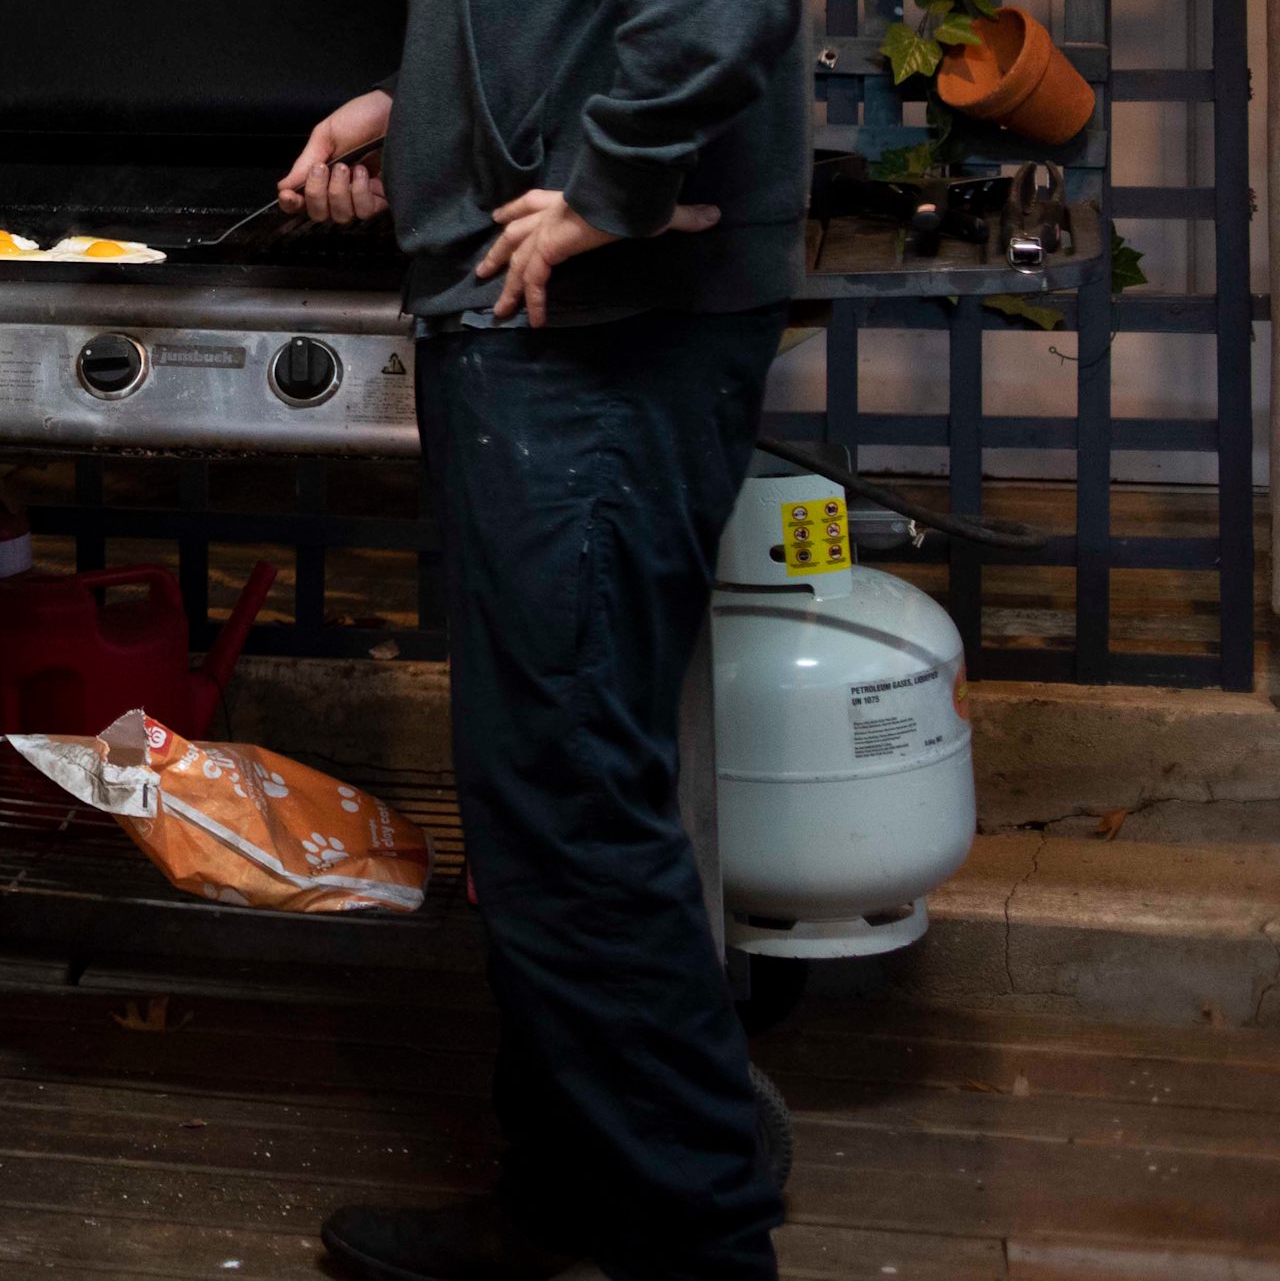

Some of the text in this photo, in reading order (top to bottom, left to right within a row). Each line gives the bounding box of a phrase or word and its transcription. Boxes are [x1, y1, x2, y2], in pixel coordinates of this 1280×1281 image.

[159, 347, 234, 365] jumbuck
[850, 682, 892, 695] PETROLEUM
[863, 695, 880, 705] 1075
